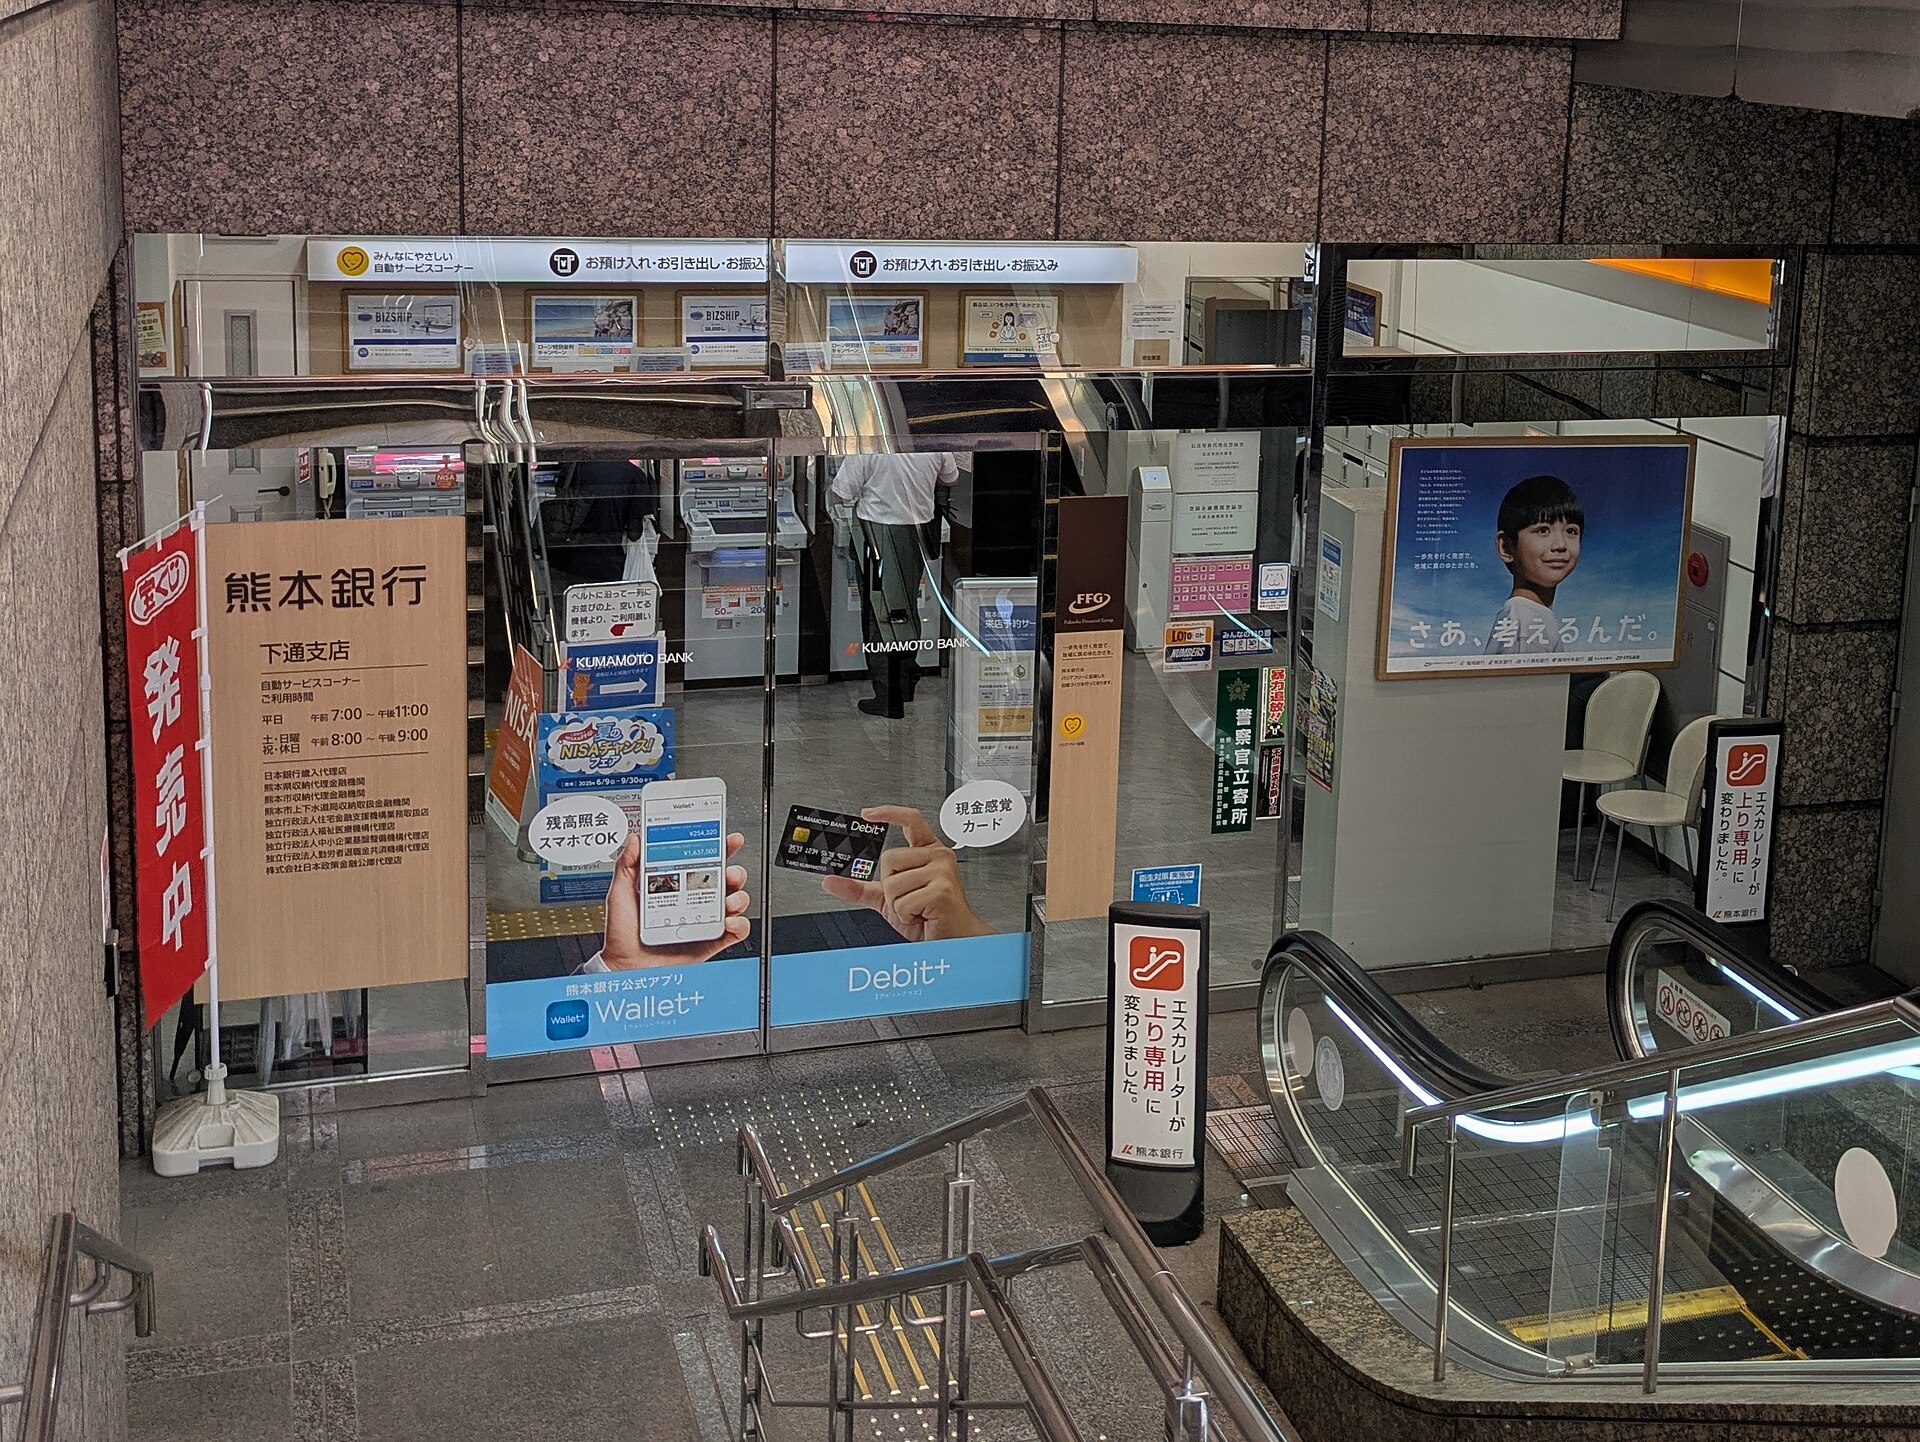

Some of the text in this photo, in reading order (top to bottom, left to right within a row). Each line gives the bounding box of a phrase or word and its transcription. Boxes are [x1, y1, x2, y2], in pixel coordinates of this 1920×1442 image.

[373, 251, 453, 262] みんなにやさしい
[373, 263, 474, 273] 自動サービスコーナー
[882, 258, 1060, 272] お預け入れ・お引き出し・お振込み
[375, 312, 413, 323] BIZSHIP
[706, 310, 740, 321] BIZSHIP
[437, 473, 456, 482] NISA
[139, 558, 180, 617] 宝くじ
[225, 563, 427, 613] 熊本銀行
[571, 588, 652, 600] ベルトに沿って一列に
[1076, 592, 1104, 605] FFG
[571, 629, 590, 637] ます。
[1409, 613, 1658, 649] さあ、考えるんだ。
[260, 640, 350, 665] 下通支店
[862, 639, 934, 654] KUMAMOTO
[937, 636, 971, 649] BANK
[1170, 646, 1206, 659] NUMBERS
[576, 651, 694, 668] KUMAMOTO BANK
[261, 676, 361, 691] 自動サービスコーナー
[261, 691, 315, 705] ご利用時間
[261, 714, 283, 725] 平日
[504, 689, 536, 742] NISA
[262, 733, 300, 745] 土・日曜
[595, 722, 624, 741] 夏の
[262, 744, 301, 755] 祝・休日
[589, 754, 622, 769] フェア
[1230, 707, 1253, 825] 警察官立寄所
[264, 766, 347, 780] 日本銀行歳入代理店
[264, 777, 366, 792] 熊本県収納代理金融機関
[144, 634, 192, 952] 発売中
[264, 789, 366, 804] 熊本市収納代理金融機関
[955, 798, 1013, 816] 現金感覚
[546, 812, 609, 831] 残高照会
[796, 814, 830, 826] KUMAMOTO
[850, 820, 886, 835] Debit+
[962, 818, 1003, 834] カード
[539, 831, 618, 849] スマホでOK
[1715, 792, 1734, 879] 変わりました。
[1731, 791, 1752, 883] 上り専用に
[1748, 791, 1767, 896] エスカレーターが
[1723, 907, 1758, 918] 熊本銀行
[849, 958, 950, 993] Debit+
[565, 973, 684, 997] 熊本銀行公式アプリ
[595, 990, 705, 1024] Wallet+
[550, 1012, 586, 1025] Wallet+
[1122, 994, 1141, 1103] 変わりました。
[1143, 997, 1168, 1114] 上り専用に
[1169, 1000, 1188, 1132] エスカレーターが
[1135, 1145, 1184, 1159] 熊本銀行
